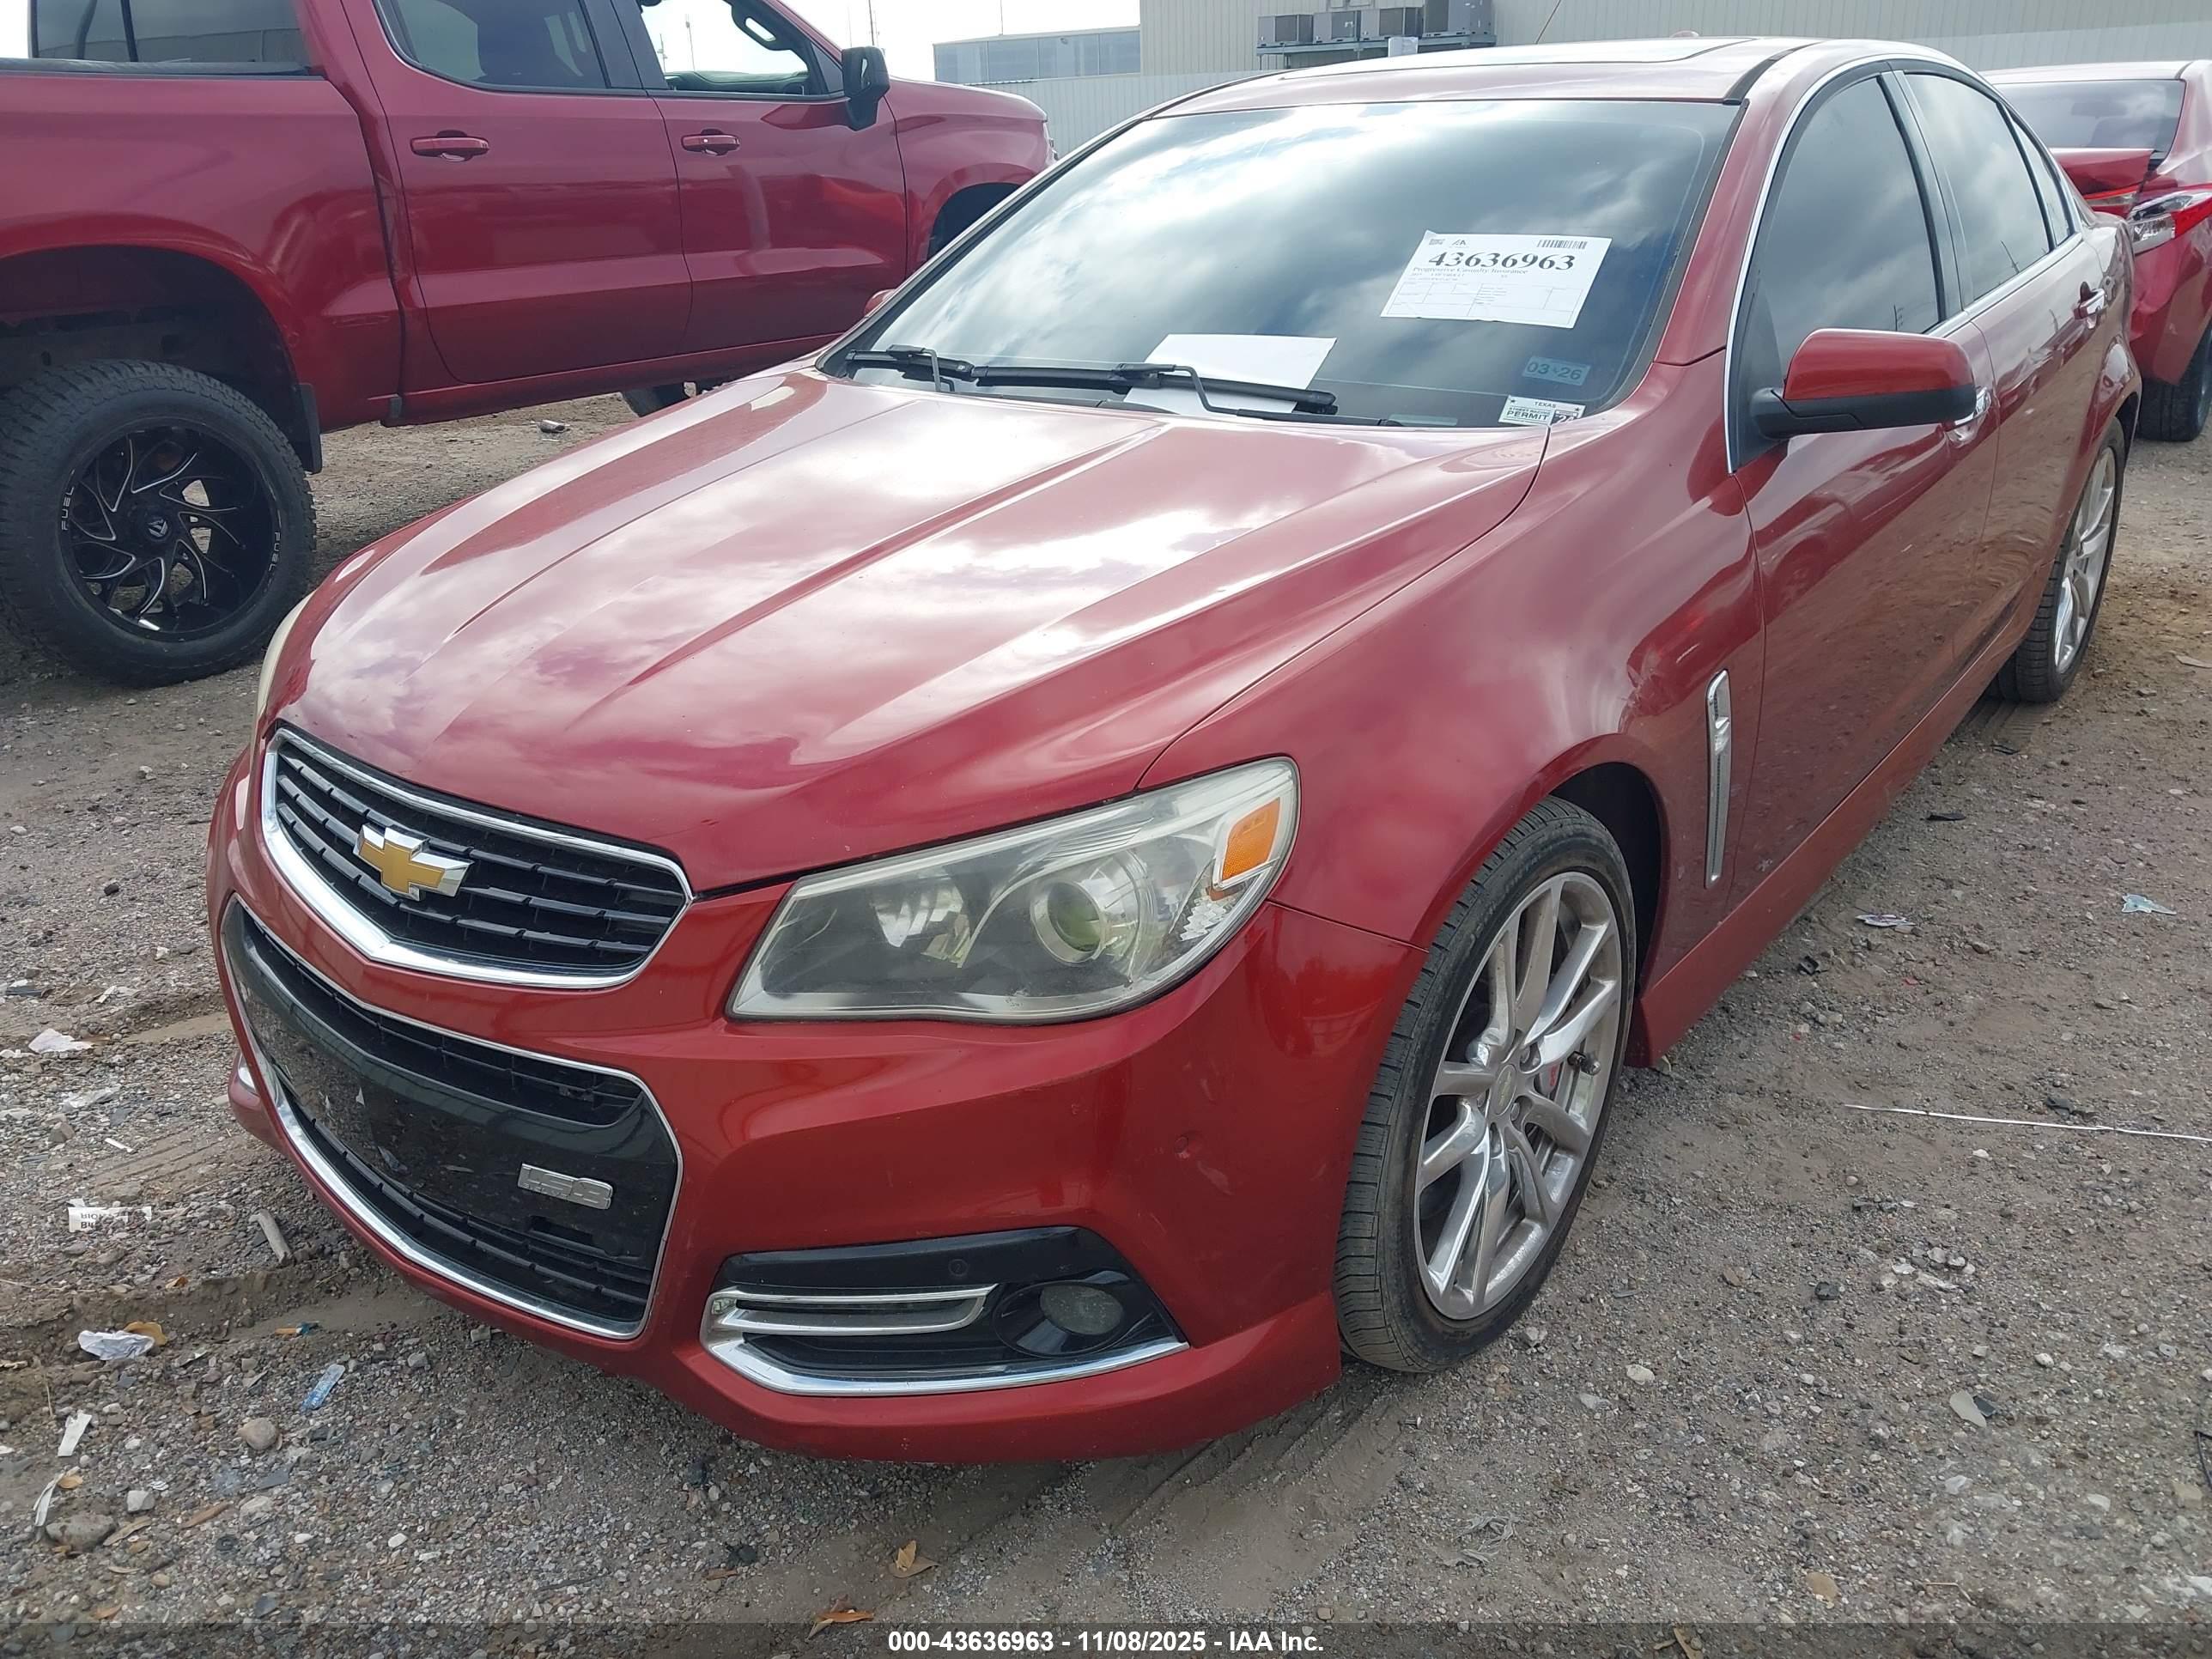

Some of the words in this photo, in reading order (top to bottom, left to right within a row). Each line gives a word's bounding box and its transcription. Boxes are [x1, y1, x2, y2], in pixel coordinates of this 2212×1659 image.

[1428, 251, 1576, 270] 43636963
[1507, 410, 1549, 421] PERMIT
[61, 486, 75, 531] FUEL
[268, 532, 281, 572] FUEL
